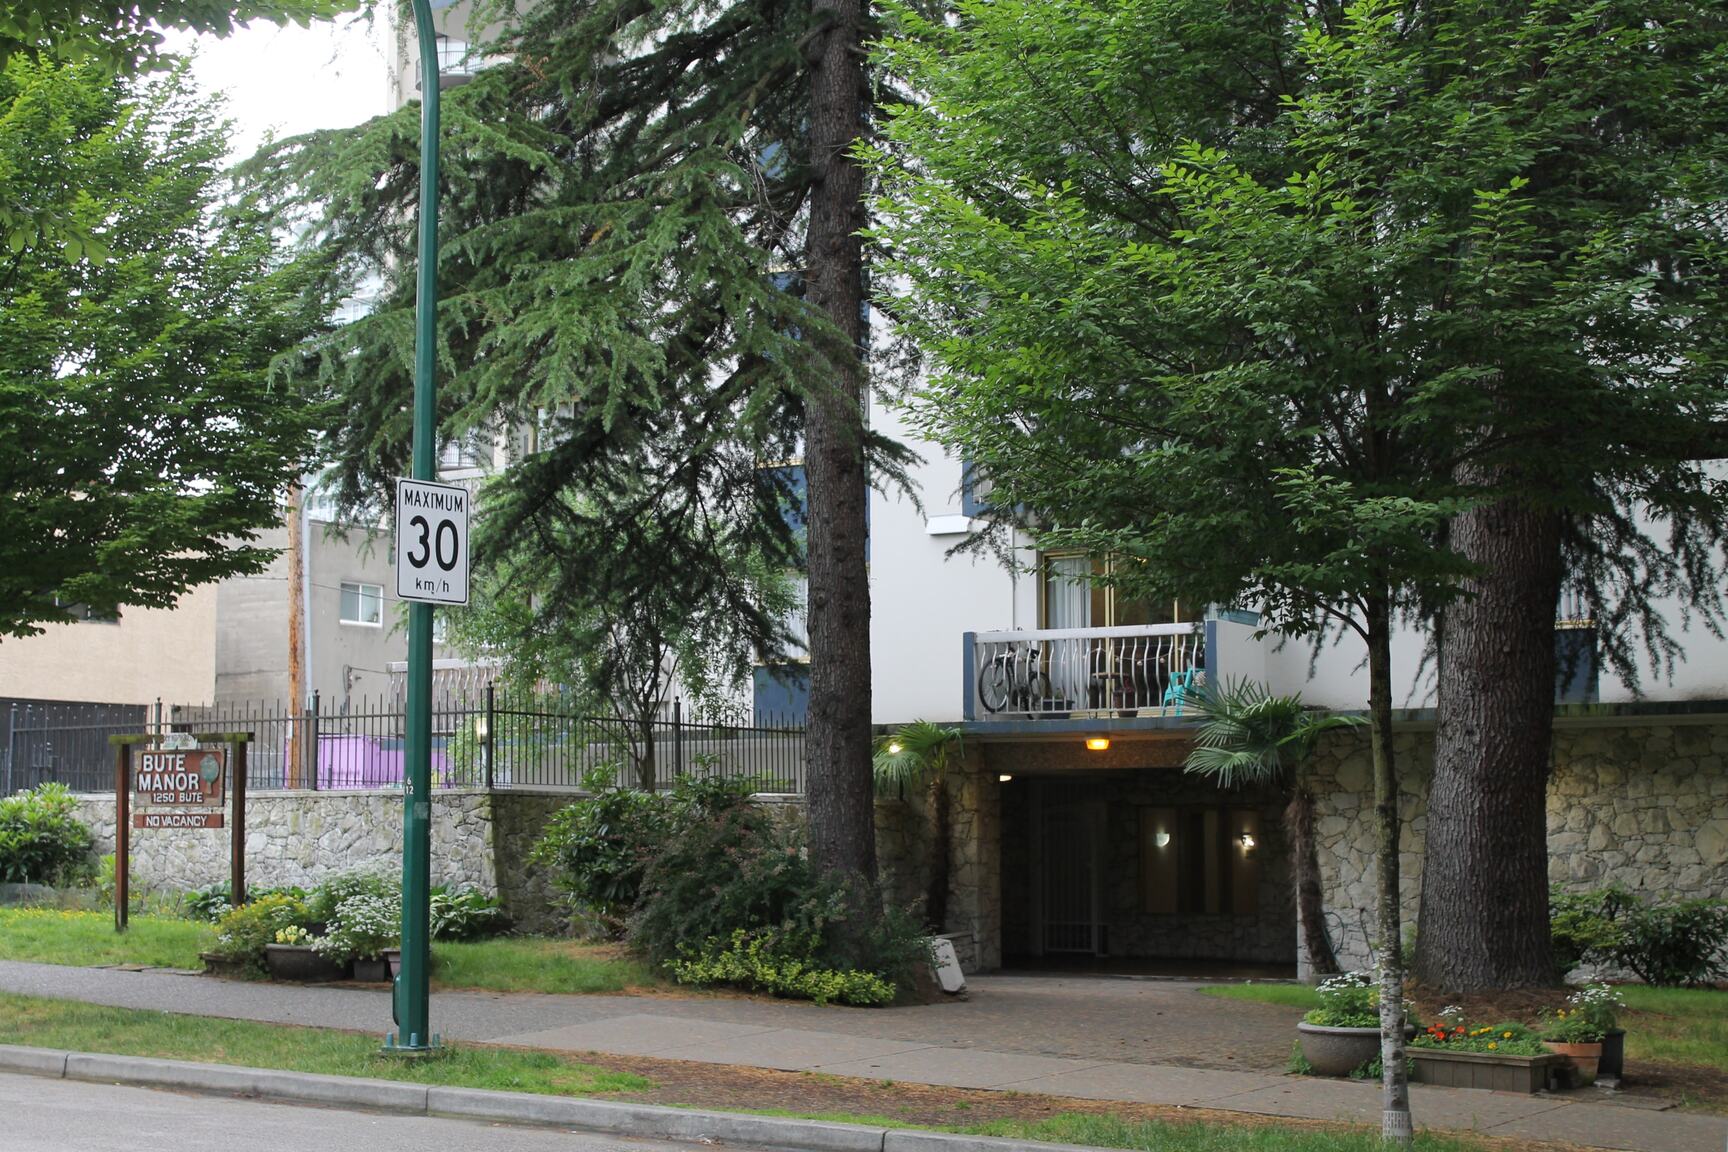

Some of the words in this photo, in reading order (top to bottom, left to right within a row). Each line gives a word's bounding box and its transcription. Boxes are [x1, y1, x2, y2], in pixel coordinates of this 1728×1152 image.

[404, 488, 463, 513] MAXIMUM
[407, 515, 459, 571] 30
[415, 577, 450, 594] km/h
[143, 754, 186, 772] BUTE
[138, 772, 199, 792] MANOR
[406, 776, 412, 785] 6
[153, 792, 175, 803] 1250
[179, 792, 204, 803] BUTE
[405, 785, 414, 795] 12
[145, 815, 160, 827] NO
[161, 815, 208, 827] VACANCY
